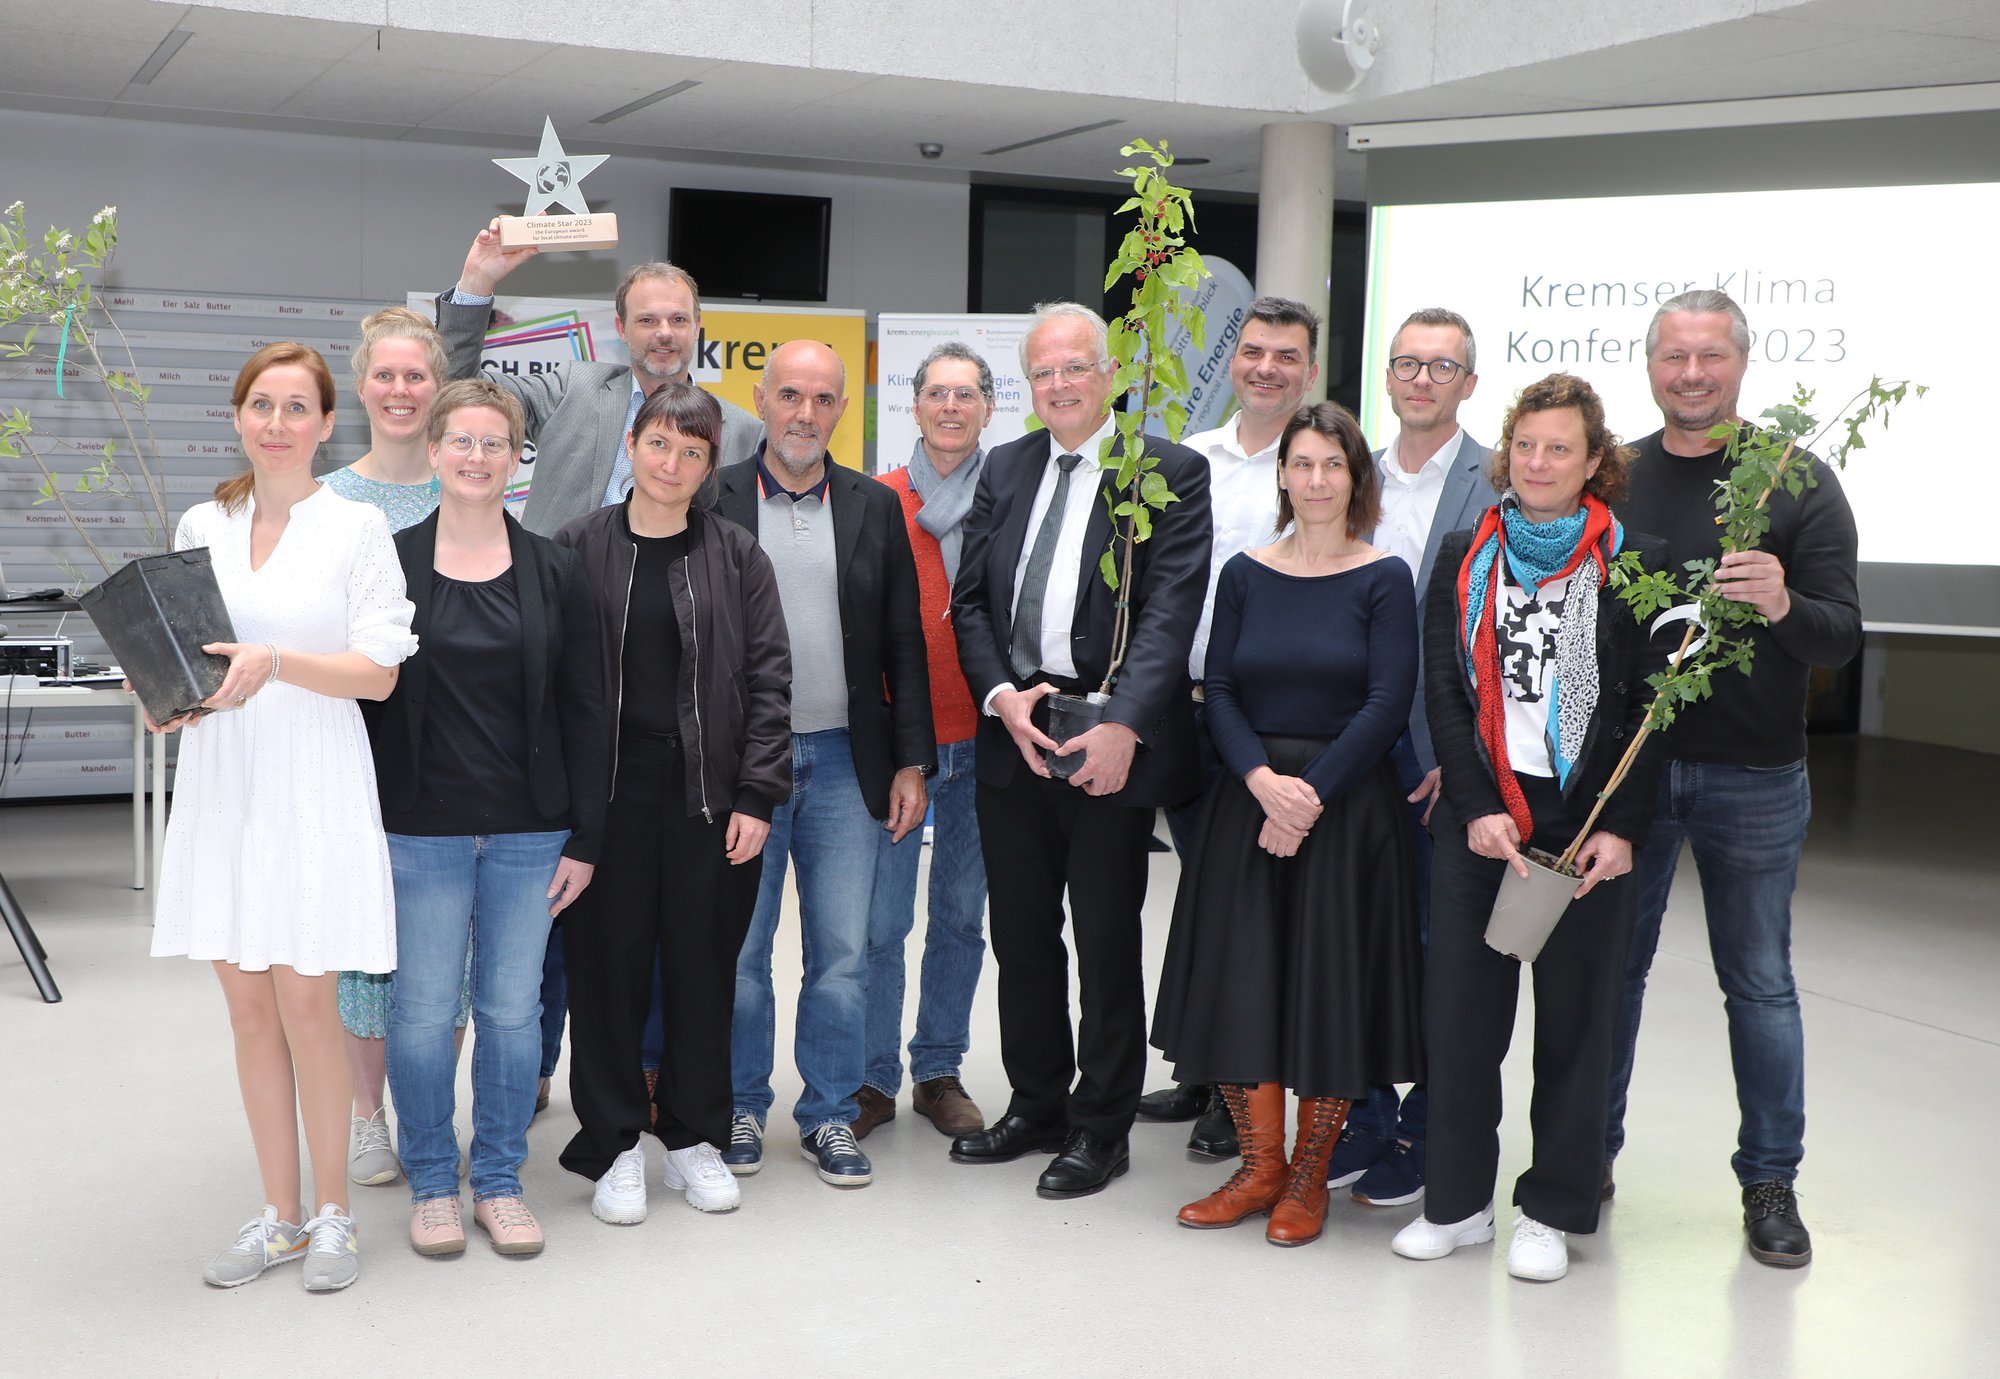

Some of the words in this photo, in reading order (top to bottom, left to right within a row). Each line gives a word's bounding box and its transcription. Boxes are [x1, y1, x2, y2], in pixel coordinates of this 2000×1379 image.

[526, 221, 556, 229] Climate
[1521, 275, 1697, 308] Kremser
[1714, 269, 1836, 306] Klima
[114, 297, 135, 306] Mehl
[162, 301, 179, 309] Eier
[184, 301, 200, 309] Salz
[206, 302, 232, 311] Butter
[279, 306, 304, 314] Butter
[329, 308, 345, 316] Eier
[329, 343, 350, 351] Niere
[697, 328, 833, 371] kre
[1198, 306, 1245, 385] Energie
[1506, 327, 1643, 364] Konfer
[35, 367, 57, 376] Mehl
[63, 367, 81, 377] Salz
[159, 372, 181, 381] Milch
[208, 374, 231, 382] Eiklar
[481, 360, 519, 376] CH
[993, 374, 1021, 390] rgie-
[995, 390, 1021, 400] nen
[206, 409, 235, 419] Salatgu
[888, 404, 903, 413] Wir
[992, 404, 1020, 413] wende
[11, 440, 22, 449] ch
[76, 442, 105, 450] Zwiebe
[187, 444, 197, 453] Öl
[202, 444, 219, 453] Salz
[224, 445, 239, 454] Pfe
[26, 515, 67, 523] Kornmehl
[109, 515, 126, 524] Salz
[64, 730, 91, 738] Butter
[81, 764, 117, 773] Mandeln
